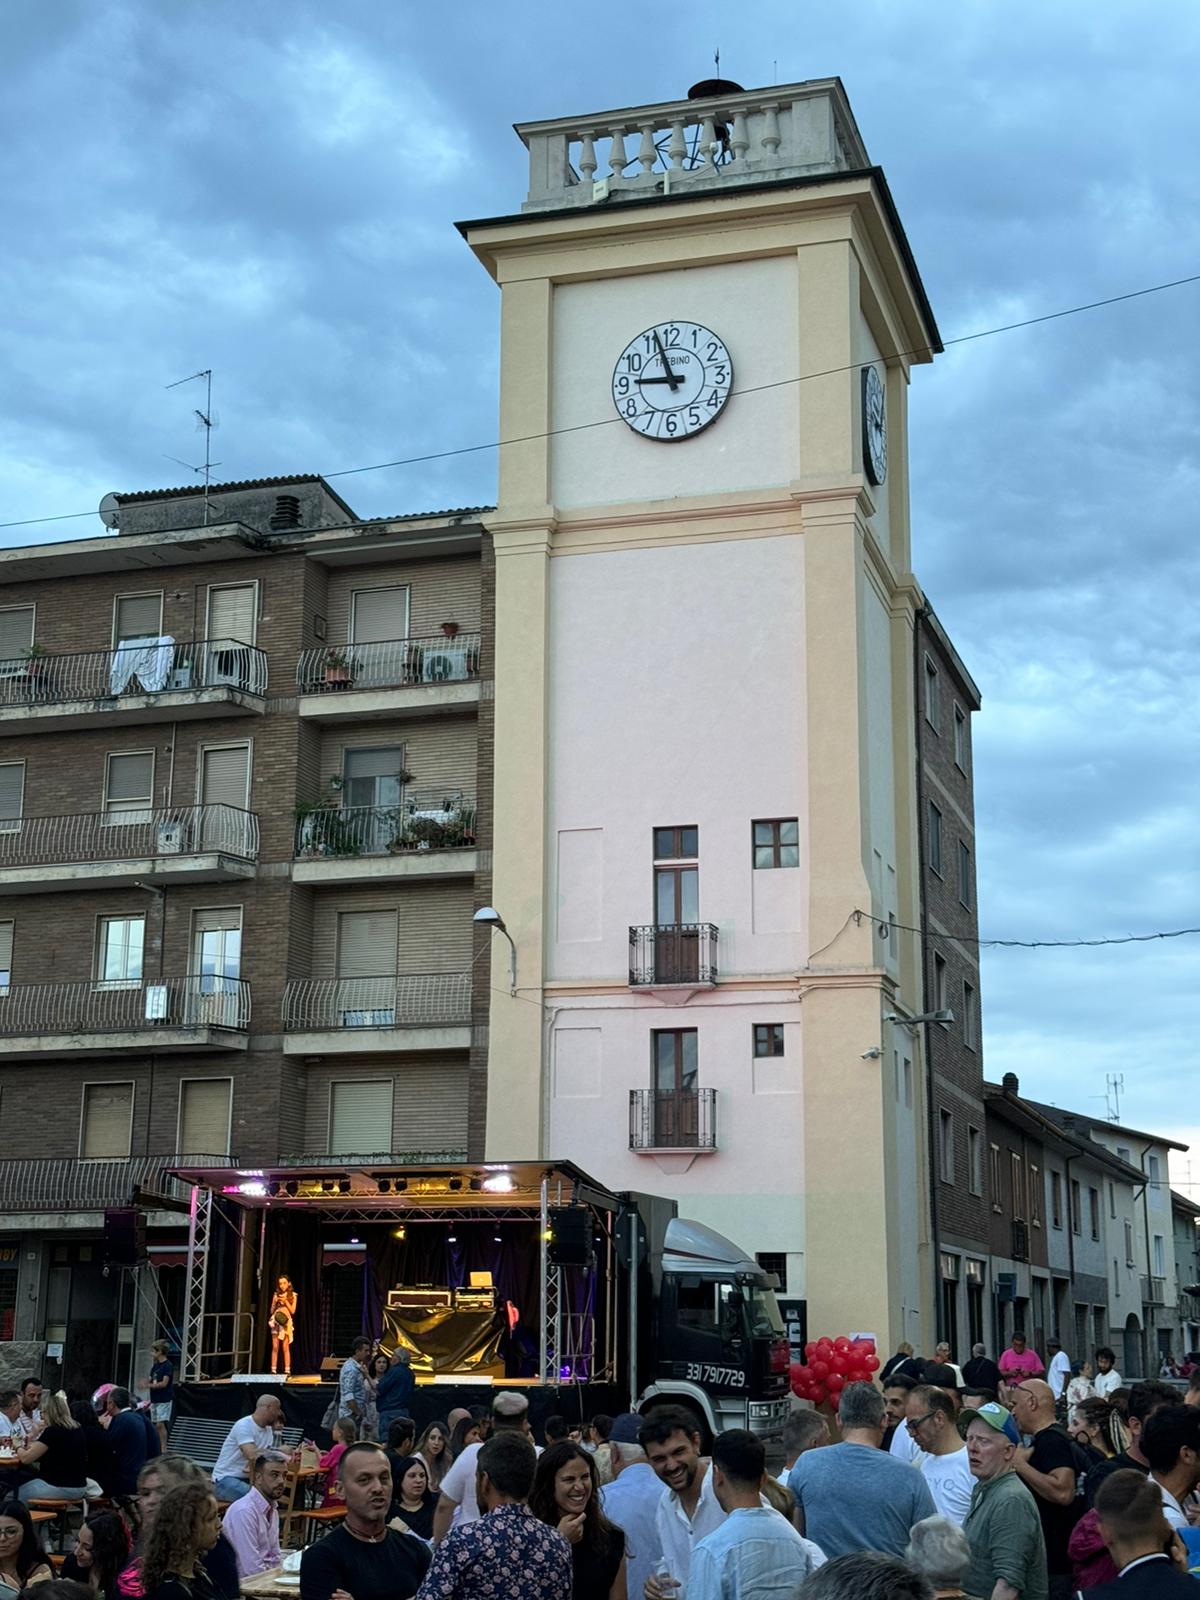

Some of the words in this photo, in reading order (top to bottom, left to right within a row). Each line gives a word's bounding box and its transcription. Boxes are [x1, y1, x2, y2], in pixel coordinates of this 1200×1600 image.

[645, 335, 658, 354] 11
[663, 328, 681, 347] 12
[691, 329, 698, 348] 1
[706, 342, 719, 362] 2
[626, 353, 642, 372] 10
[714, 365, 726, 385] 3
[618, 376, 630, 395] 9
[626, 398, 637, 417] 8
[706, 389, 719, 408] 4
[644, 410, 656, 430] 7
[665, 413, 677, 433] 6
[688, 406, 701, 426] 5
